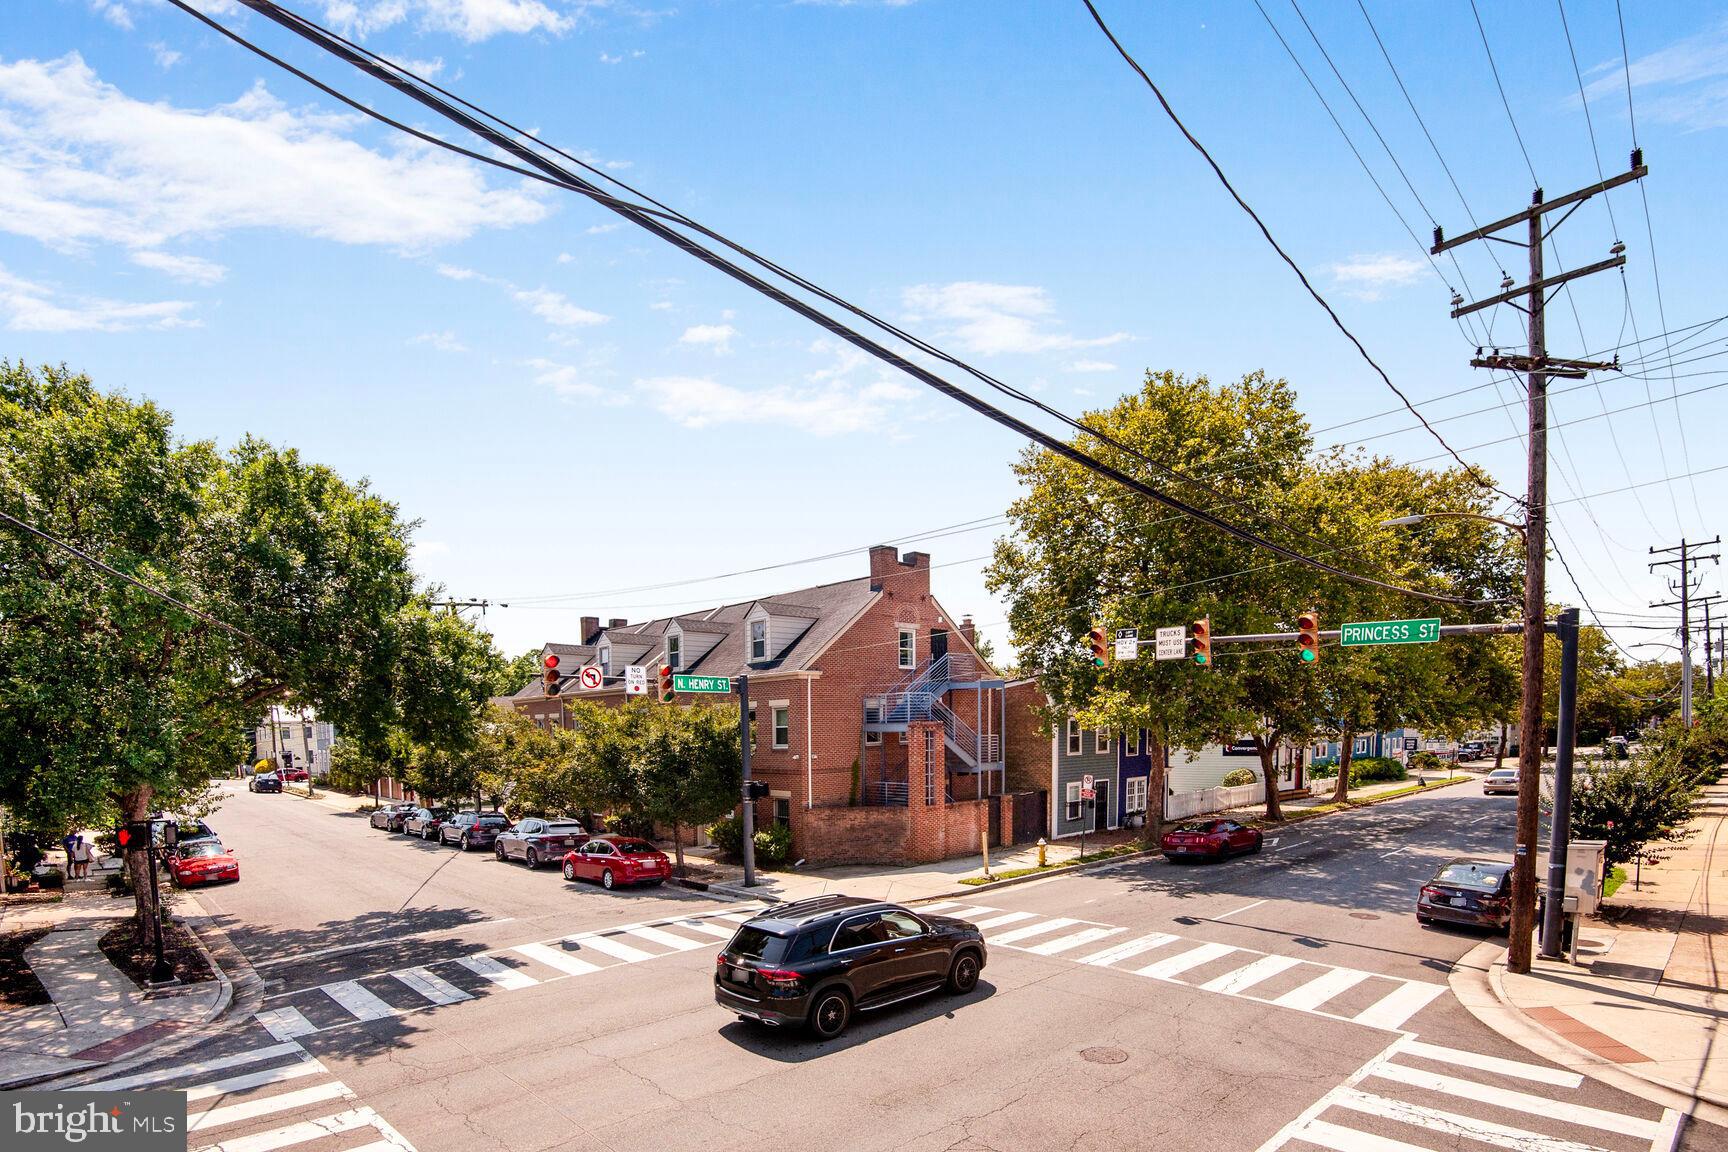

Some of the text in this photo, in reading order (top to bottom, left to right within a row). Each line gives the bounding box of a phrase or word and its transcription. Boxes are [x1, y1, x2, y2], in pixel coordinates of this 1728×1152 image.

[1344, 623, 1436, 641] PRINCESS ST
[677, 679, 729, 690] N. HENRY ST.
